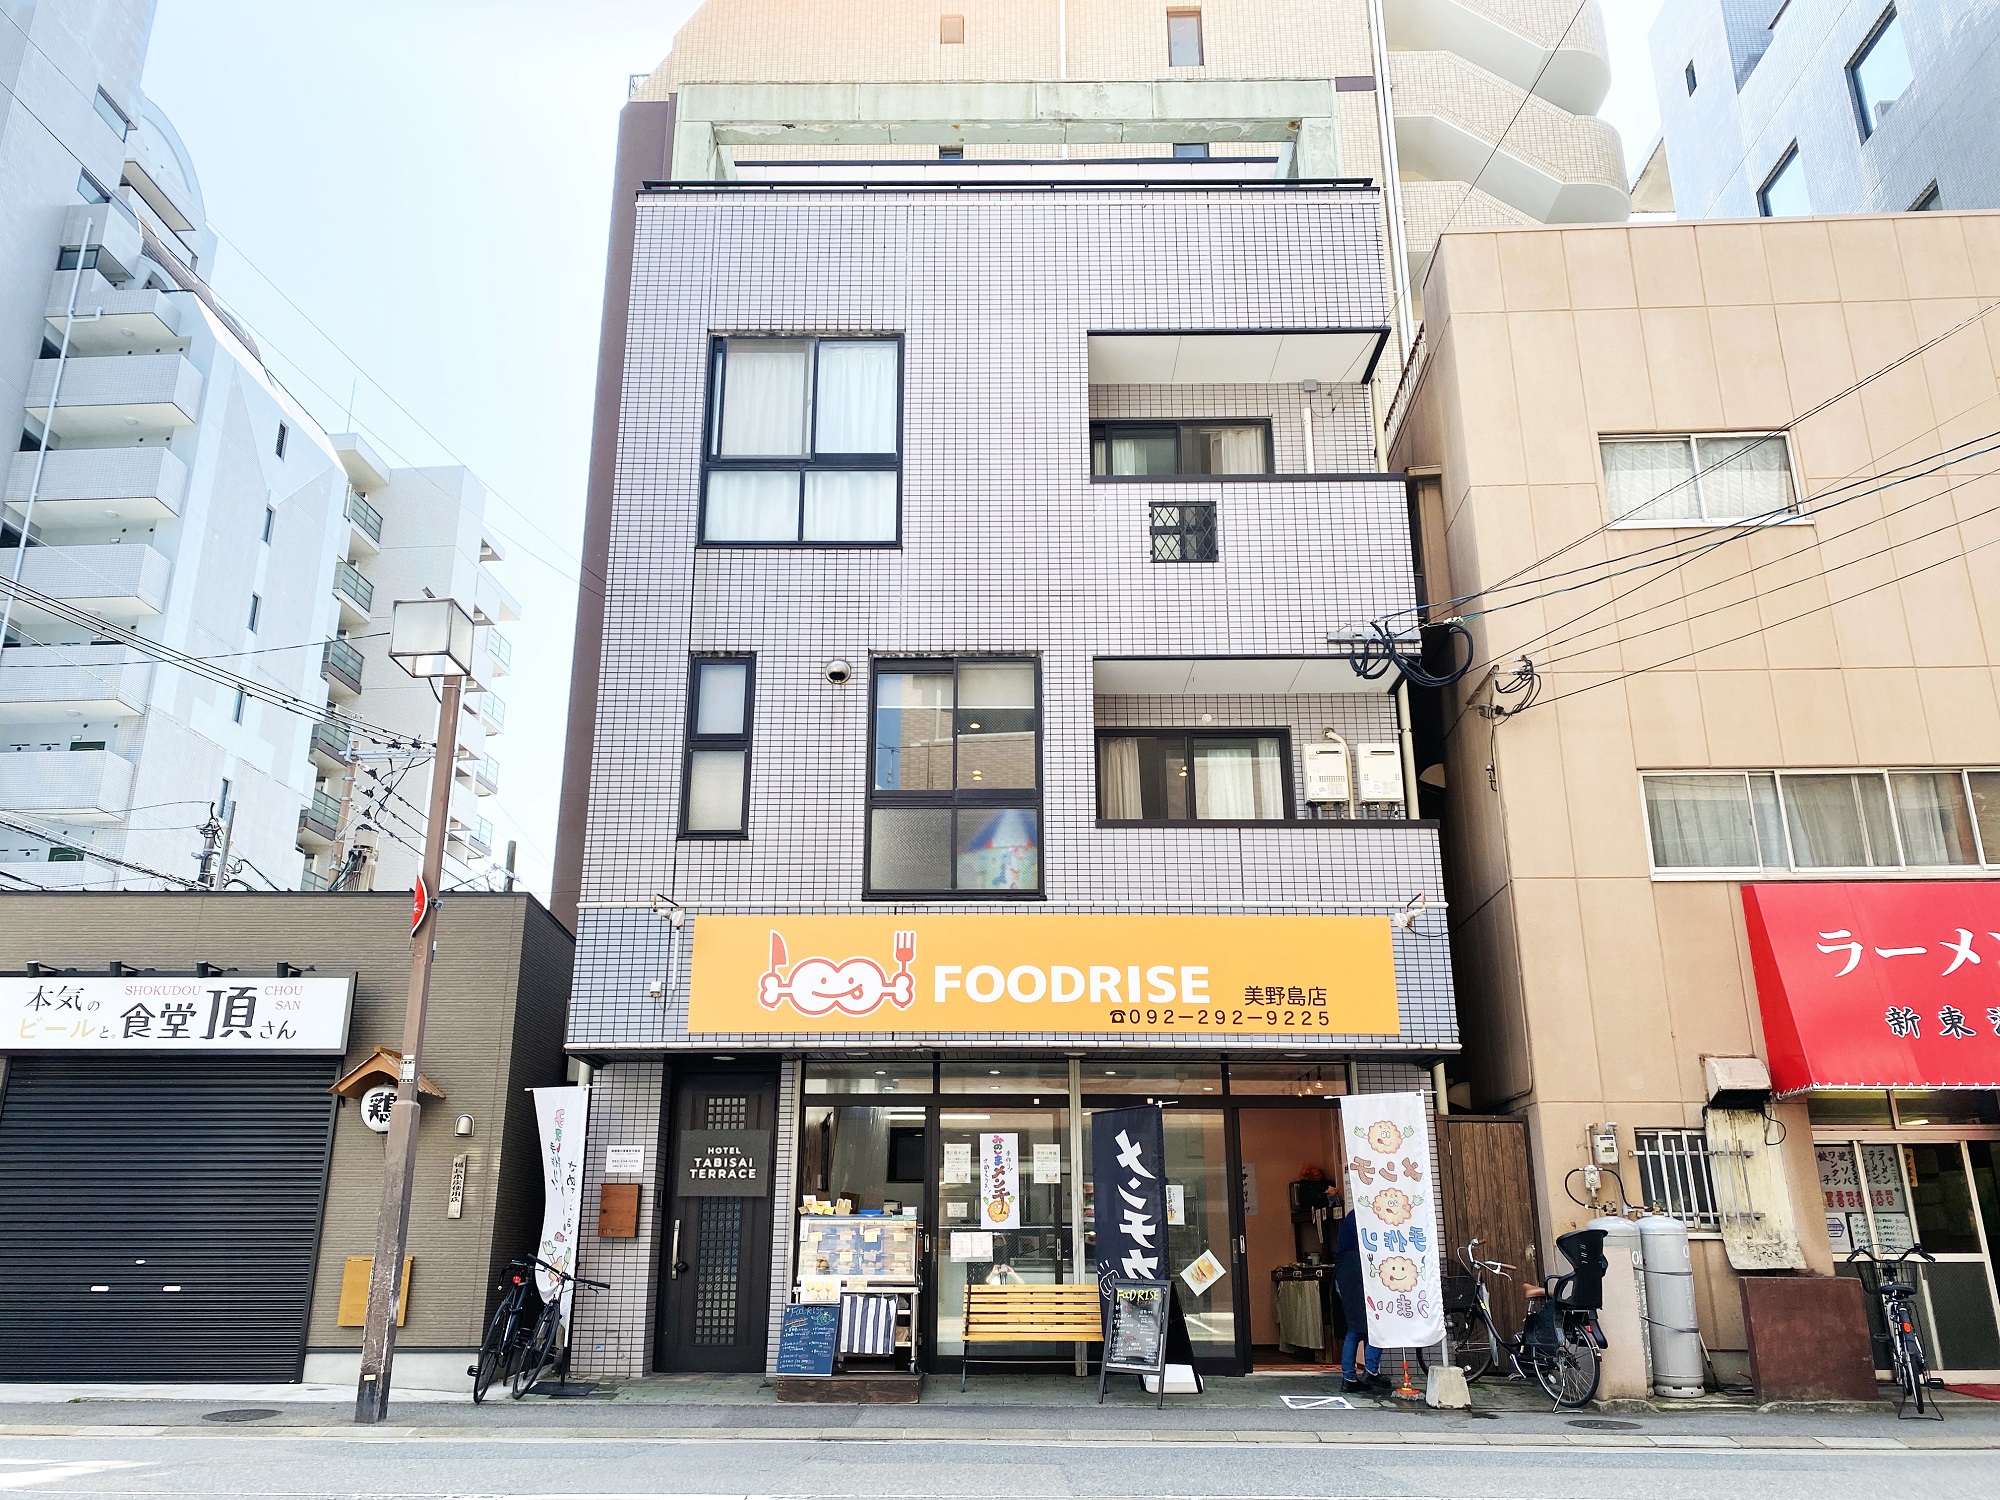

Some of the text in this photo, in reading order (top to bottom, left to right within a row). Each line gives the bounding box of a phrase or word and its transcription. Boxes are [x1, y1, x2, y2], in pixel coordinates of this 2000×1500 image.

[1816, 928, 2000, 978] ラーメ
[124, 985, 202, 996] SHOKUDOU
[264, 985, 303, 996] CHOU
[934, 964, 1211, 1004] FOODRISE
[23, 985, 100, 1012] 本気の
[1244, 985, 1329, 1007] 美野島店
[275, 1000, 302, 1011] SAN
[1128, 1009, 1332, 1027] 092-292-9225
[707, 1146, 742, 1155] HOTEL
[693, 1157, 754, 1168] TABISAI
[1878, 1150, 1891, 1184] ラーメン
[689, 1169, 757, 1179] TERRACE
